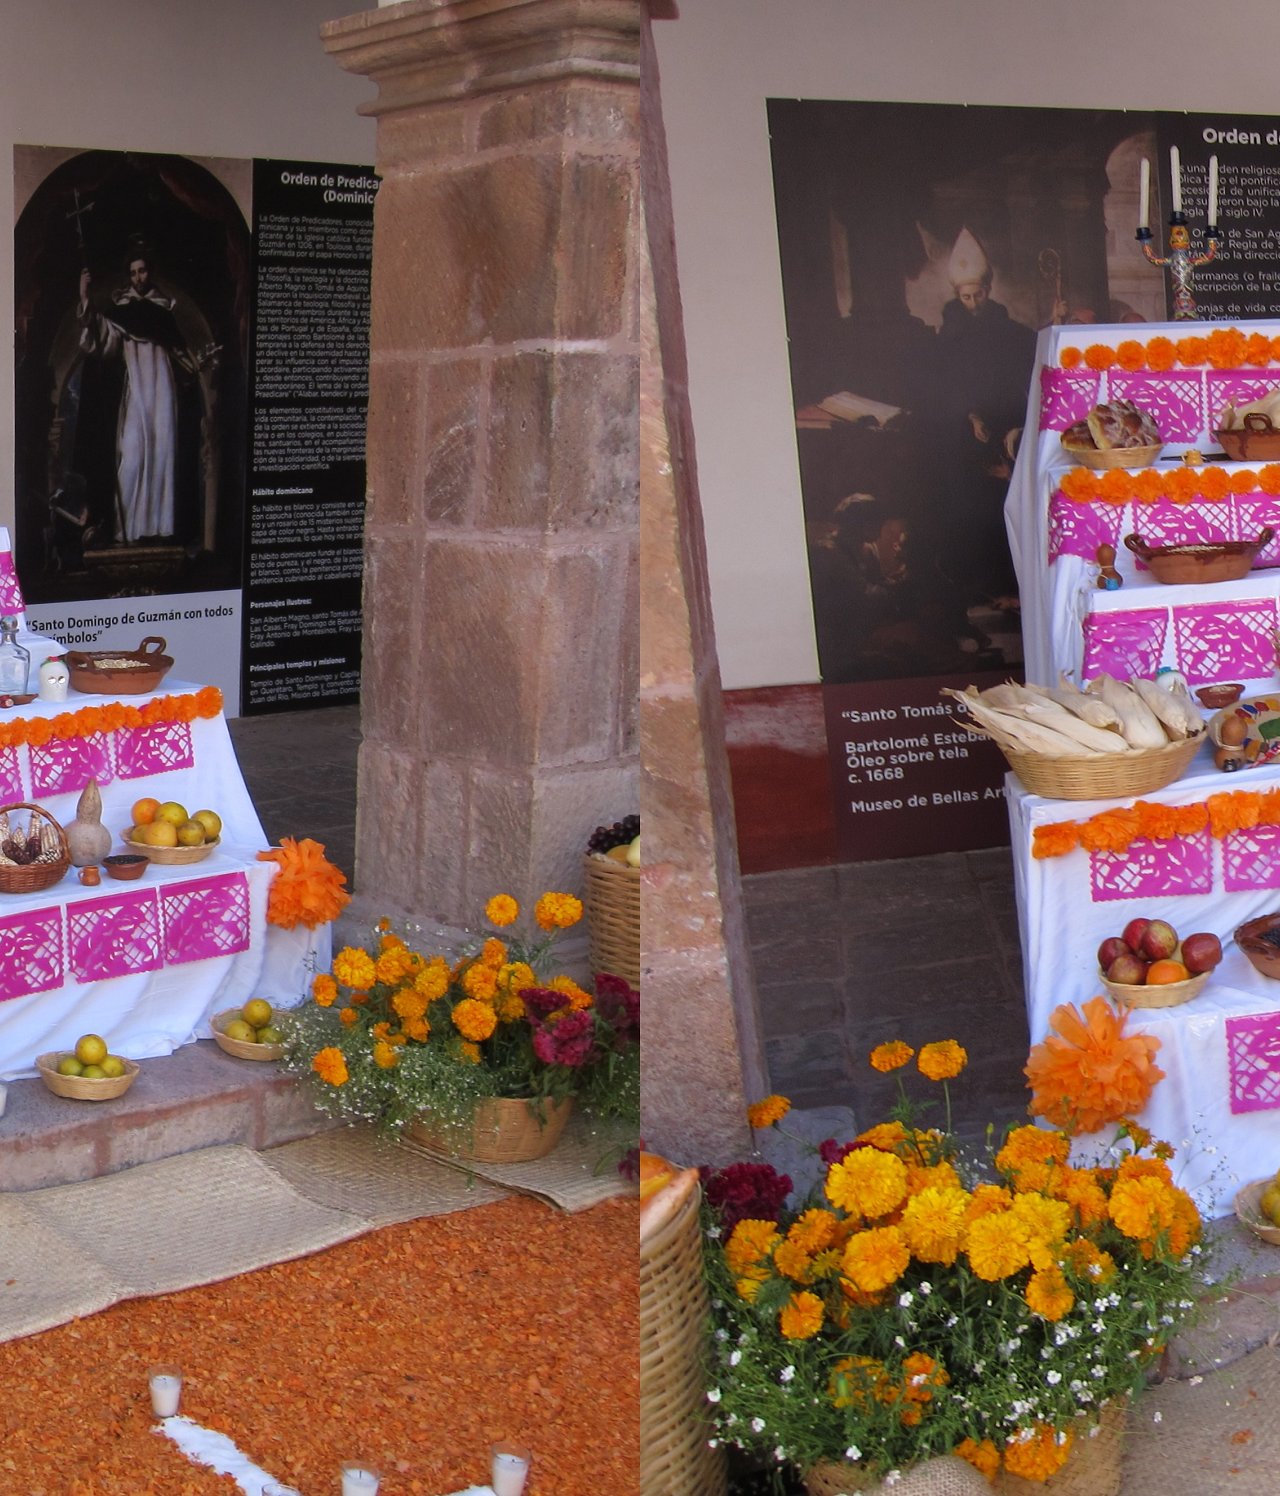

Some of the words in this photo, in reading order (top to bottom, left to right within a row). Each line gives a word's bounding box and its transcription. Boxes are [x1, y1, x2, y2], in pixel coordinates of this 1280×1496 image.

[1202, 128, 1261, 144] Orden
[1188, 165, 1206, 173] una
[281, 172, 317, 185] Orden
[320, 174, 334, 186] de
[1229, 177, 1238, 185] el
[1230, 187, 1243, 196] de
[1247, 198, 1268, 208] bajo
[1226, 208, 1249, 218] siglo
[1252, 208, 1264, 217] IV.
[1229, 229, 1241, 238] de
[1245, 229, 1263, 238] San
[1229, 240, 1257, 250] Regla
[1261, 241, 1274, 249] de
[1243, 272, 1254, 281] (o
[1247, 283, 1259, 291] de
[1228, 304, 1241, 312] de
[1245, 304, 1266, 312] vida
[253, 488, 274, 496] Hábito
[276, 487, 313, 495] dominicano
[250, 601, 285, 609] Personajes
[67, 614, 118, 631] Domingo
[122, 613, 134, 625] de
[138, 608, 181, 623] Guzmán
[184, 608, 202, 619] con
[205, 605, 233, 617] todos
[250, 663, 285, 672] Principales
[287, 661, 312, 670] templos
[319, 657, 346, 666] misiones
[842, 709, 897, 723] “Santo
[902, 703, 952, 718] Tomás
[845, 734, 929, 754] Bartolomé
[847, 752, 885, 768] Óleo
[890, 751, 934, 765] sobre
[940, 747, 969, 758] tela
[848, 774, 862, 783] c.
[866, 767, 904, 782] 1668
[852, 799, 903, 813] Museo
[908, 795, 928, 808] de
[932, 790, 979, 805] Bellas
